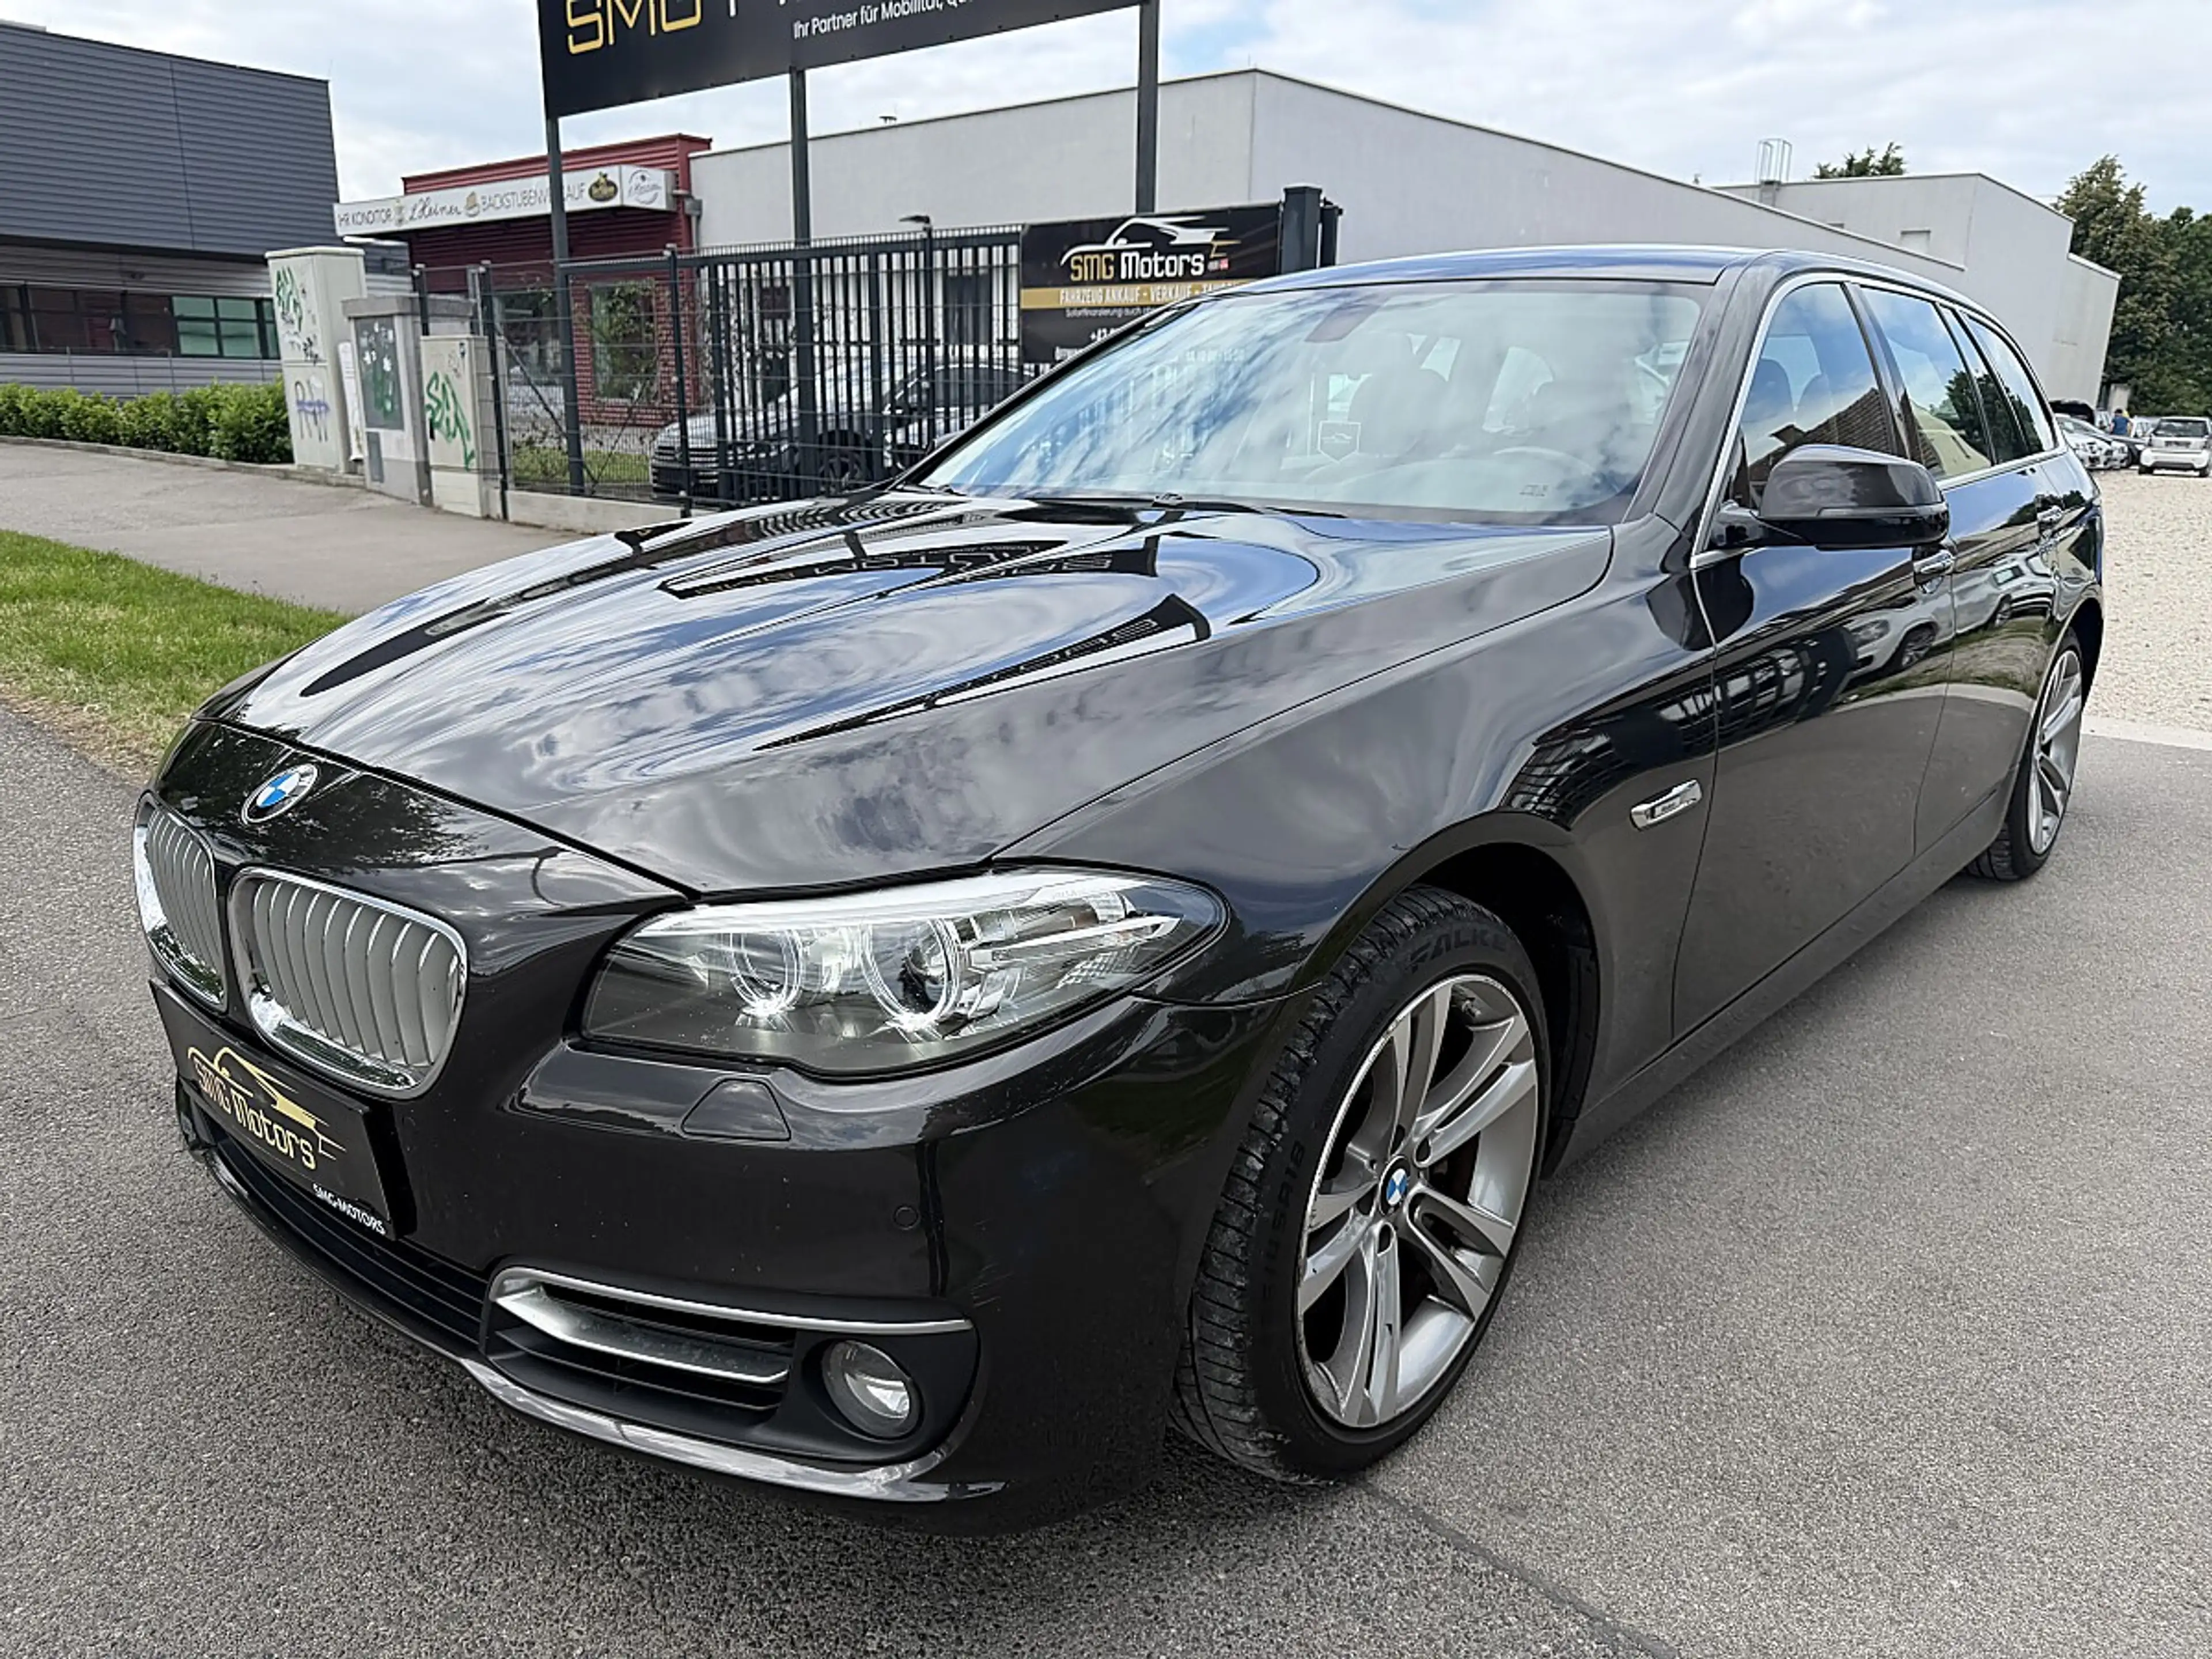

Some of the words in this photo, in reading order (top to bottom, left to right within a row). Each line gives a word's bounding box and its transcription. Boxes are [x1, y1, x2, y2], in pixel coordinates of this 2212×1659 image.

[794, 20, 809, 40] Ihr
[811, 10, 858, 36] Partner
[860, 5, 879, 25] für
[1070, 253, 1115, 281] SMG
[1120, 251, 1205, 277] Motors
[230, 1088, 316, 1170] Motors
